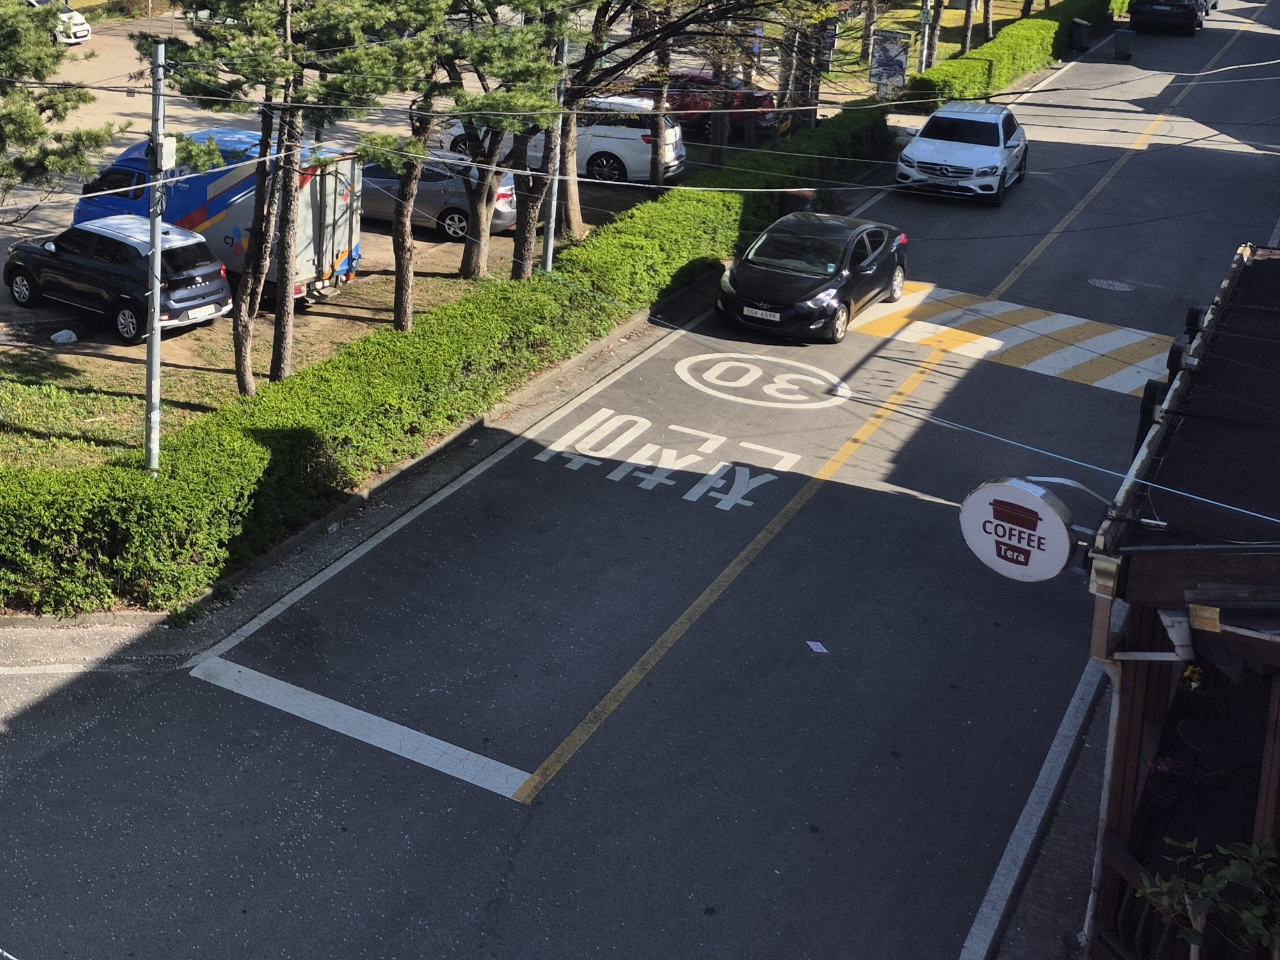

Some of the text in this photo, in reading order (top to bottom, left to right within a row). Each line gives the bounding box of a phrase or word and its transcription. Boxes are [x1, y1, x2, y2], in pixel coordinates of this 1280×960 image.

[223, 235, 235, 248] CJ
[702, 361, 826, 401] 30
[532, 408, 802, 511] 천천히
[982, 520, 1047, 552] COFFEE
[999, 545, 1026, 562] Tera
